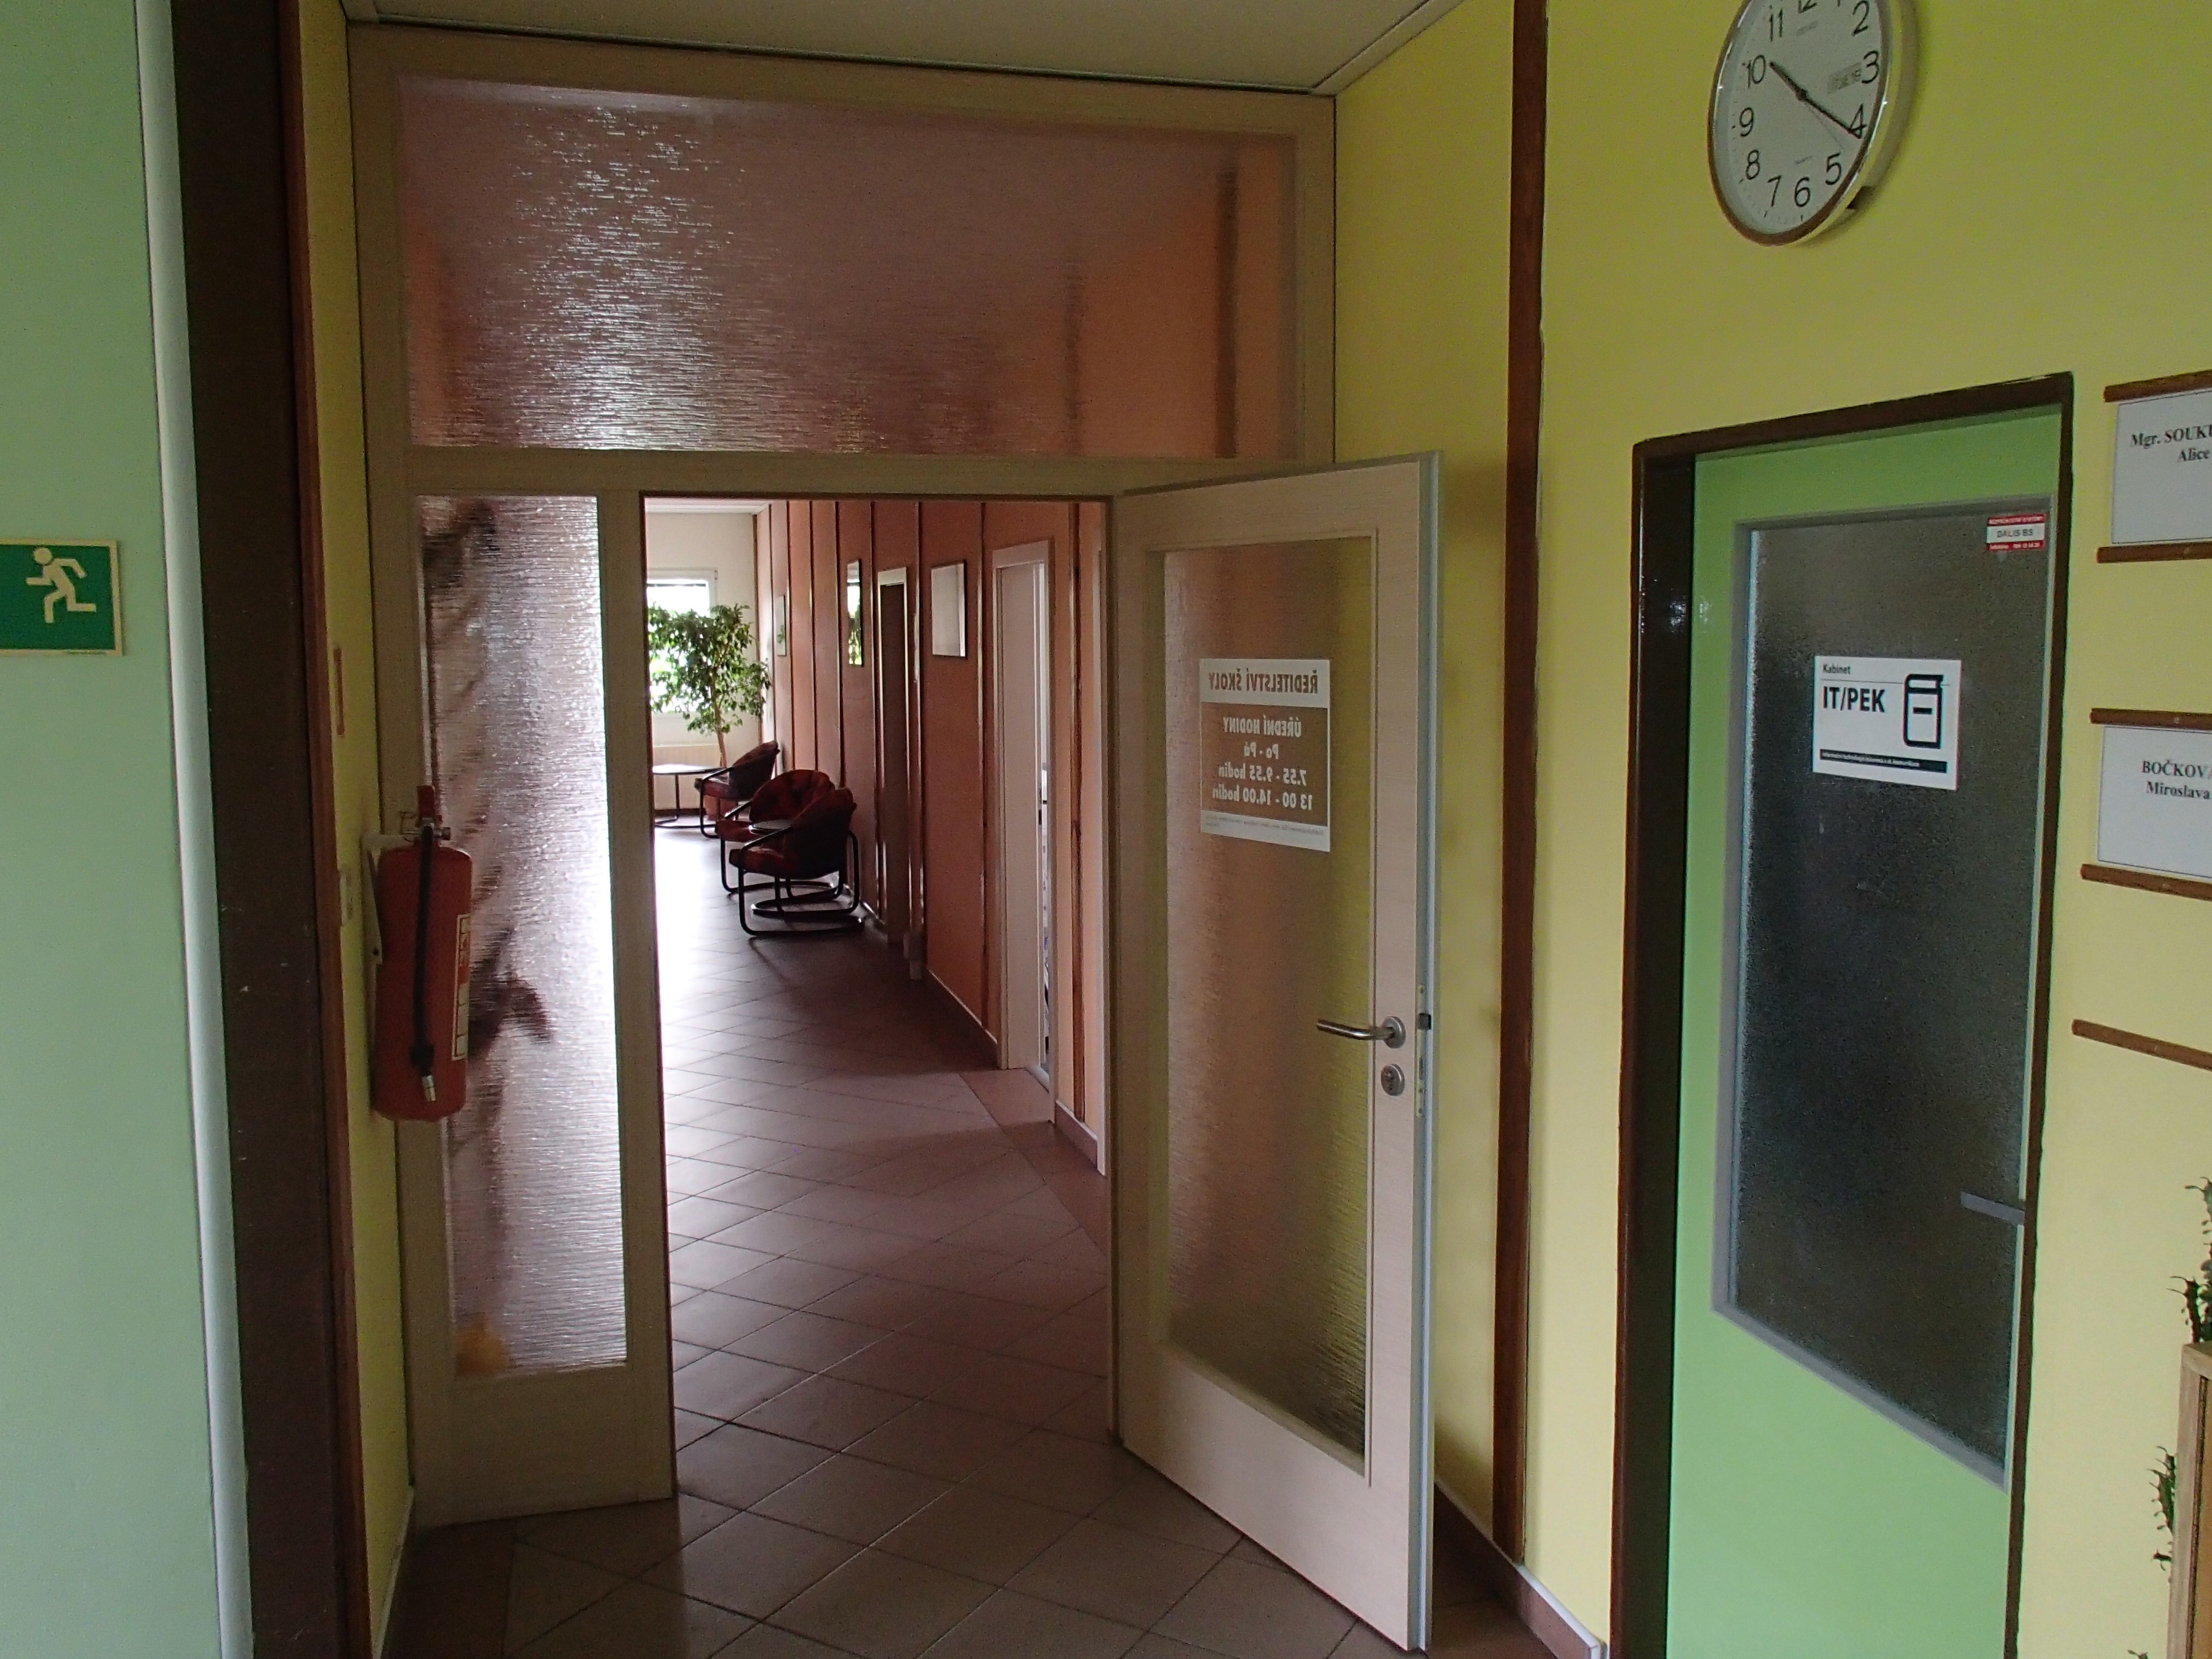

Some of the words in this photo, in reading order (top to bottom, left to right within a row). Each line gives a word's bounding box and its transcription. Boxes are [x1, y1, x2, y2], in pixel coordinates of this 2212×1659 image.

[1768, 8, 1783, 42] 11
[1851, 1, 1869, 37] 2
[1747, 55, 1766, 88] 10
[1861, 51, 1879, 84] 3
[1739, 108, 1755, 137] 9
[1849, 104, 1866, 139] 4
[1745, 150, 1760, 180] 8
[1825, 153, 1842, 185] 5
[1767, 175, 1781, 206] 7
[1794, 177, 1811, 207] 6
[2131, 433, 2160, 449] Mgr.
[2177, 447, 2210, 462] Alice
[1823, 663, 1851, 675] Kabinet
[1823, 686, 1885, 712] IT/PEK
[2142, 758, 2212, 779] BOČKOV
[2146, 780, 2210, 799] Miroslava
